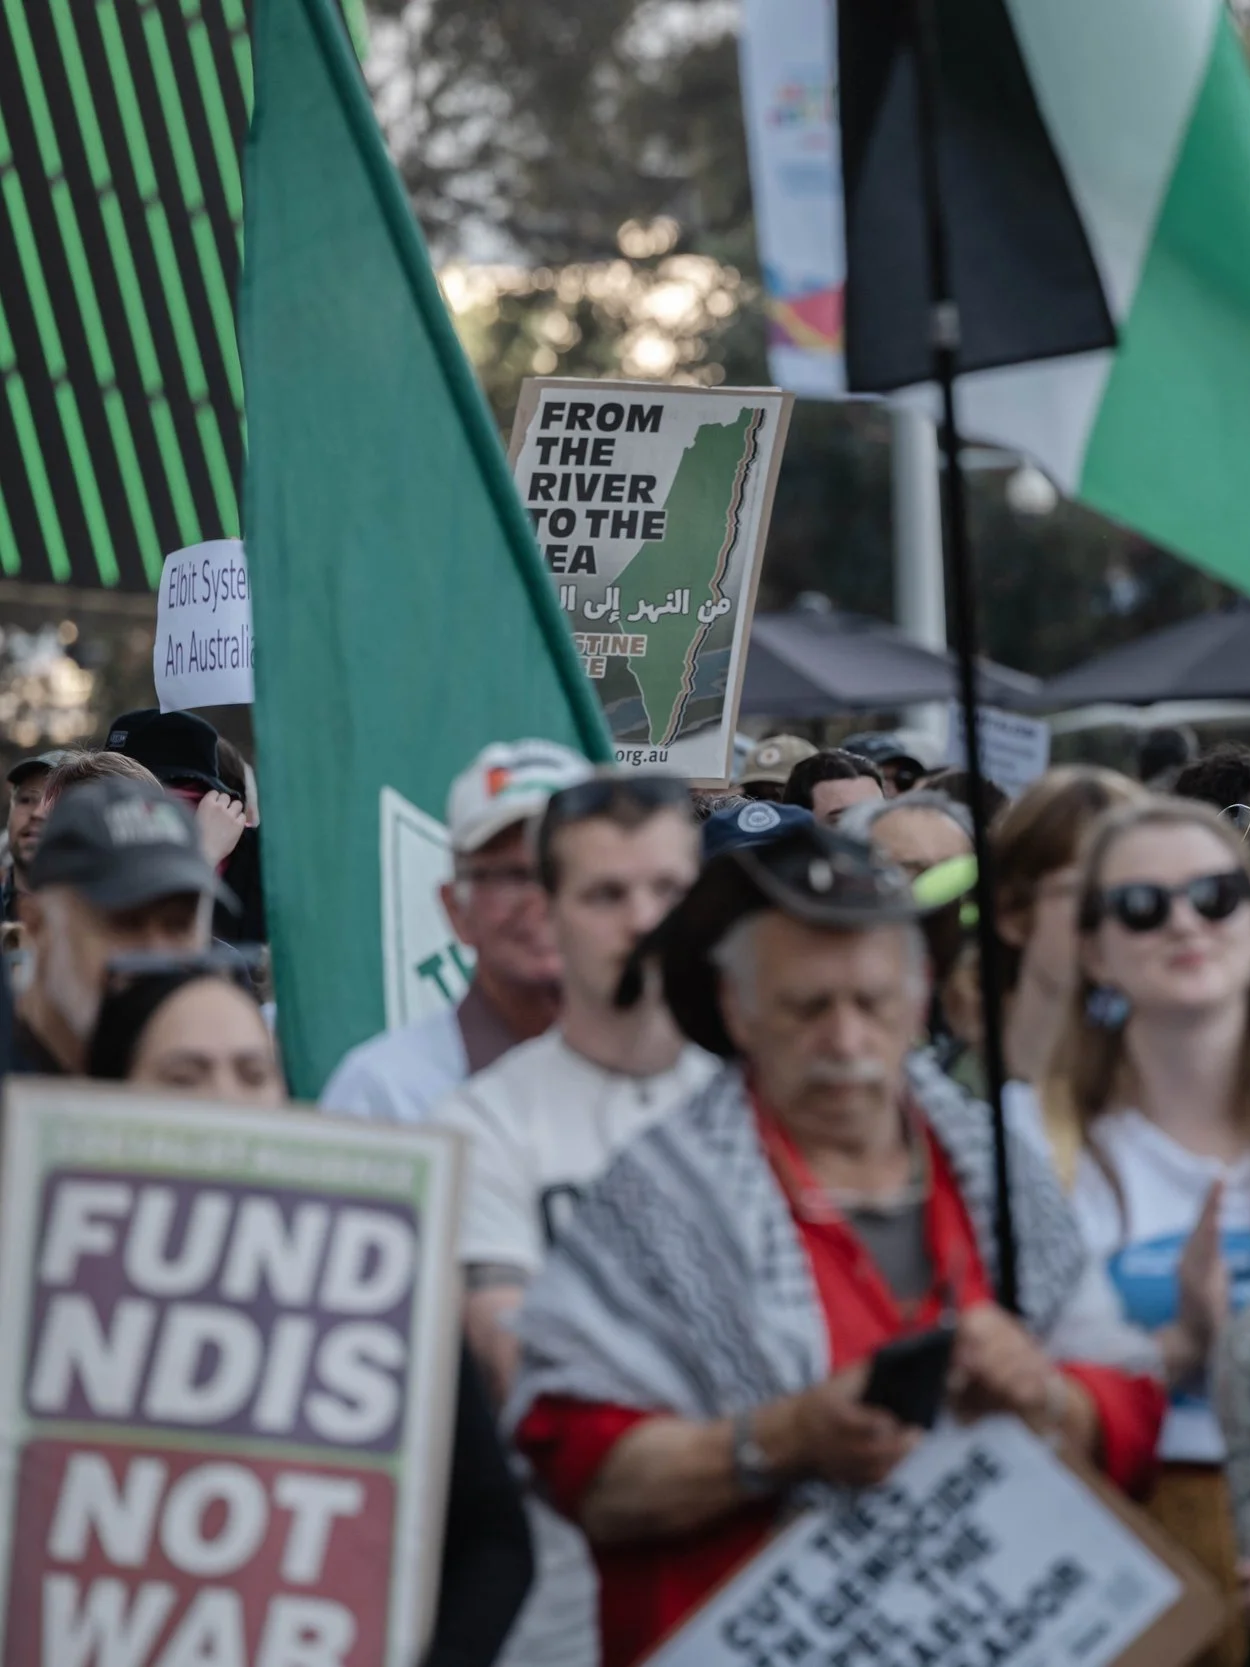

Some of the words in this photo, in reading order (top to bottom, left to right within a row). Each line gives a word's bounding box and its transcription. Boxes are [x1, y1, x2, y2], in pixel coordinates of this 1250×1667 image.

[540, 402, 664, 433] FROM
[536, 436, 616, 466] THE
[528, 472, 656, 504] RIVER
[526, 508, 576, 538] TO
[585, 509, 666, 540] THE
[543, 544, 597, 574] EA
[168, 561, 197, 609] Elbit
[584, 587, 620, 623] إلى
[628, 588, 690, 624] النهر
[698, 598, 731, 624] من
[165, 634, 184, 677] An
[615, 749, 668, 766] org.au
[38, 1180, 417, 1314] FUND
[28, 1293, 406, 1445] NDIS
[47, 1450, 363, 1585] NOT
[41, 1572, 357, 1667] WAR
